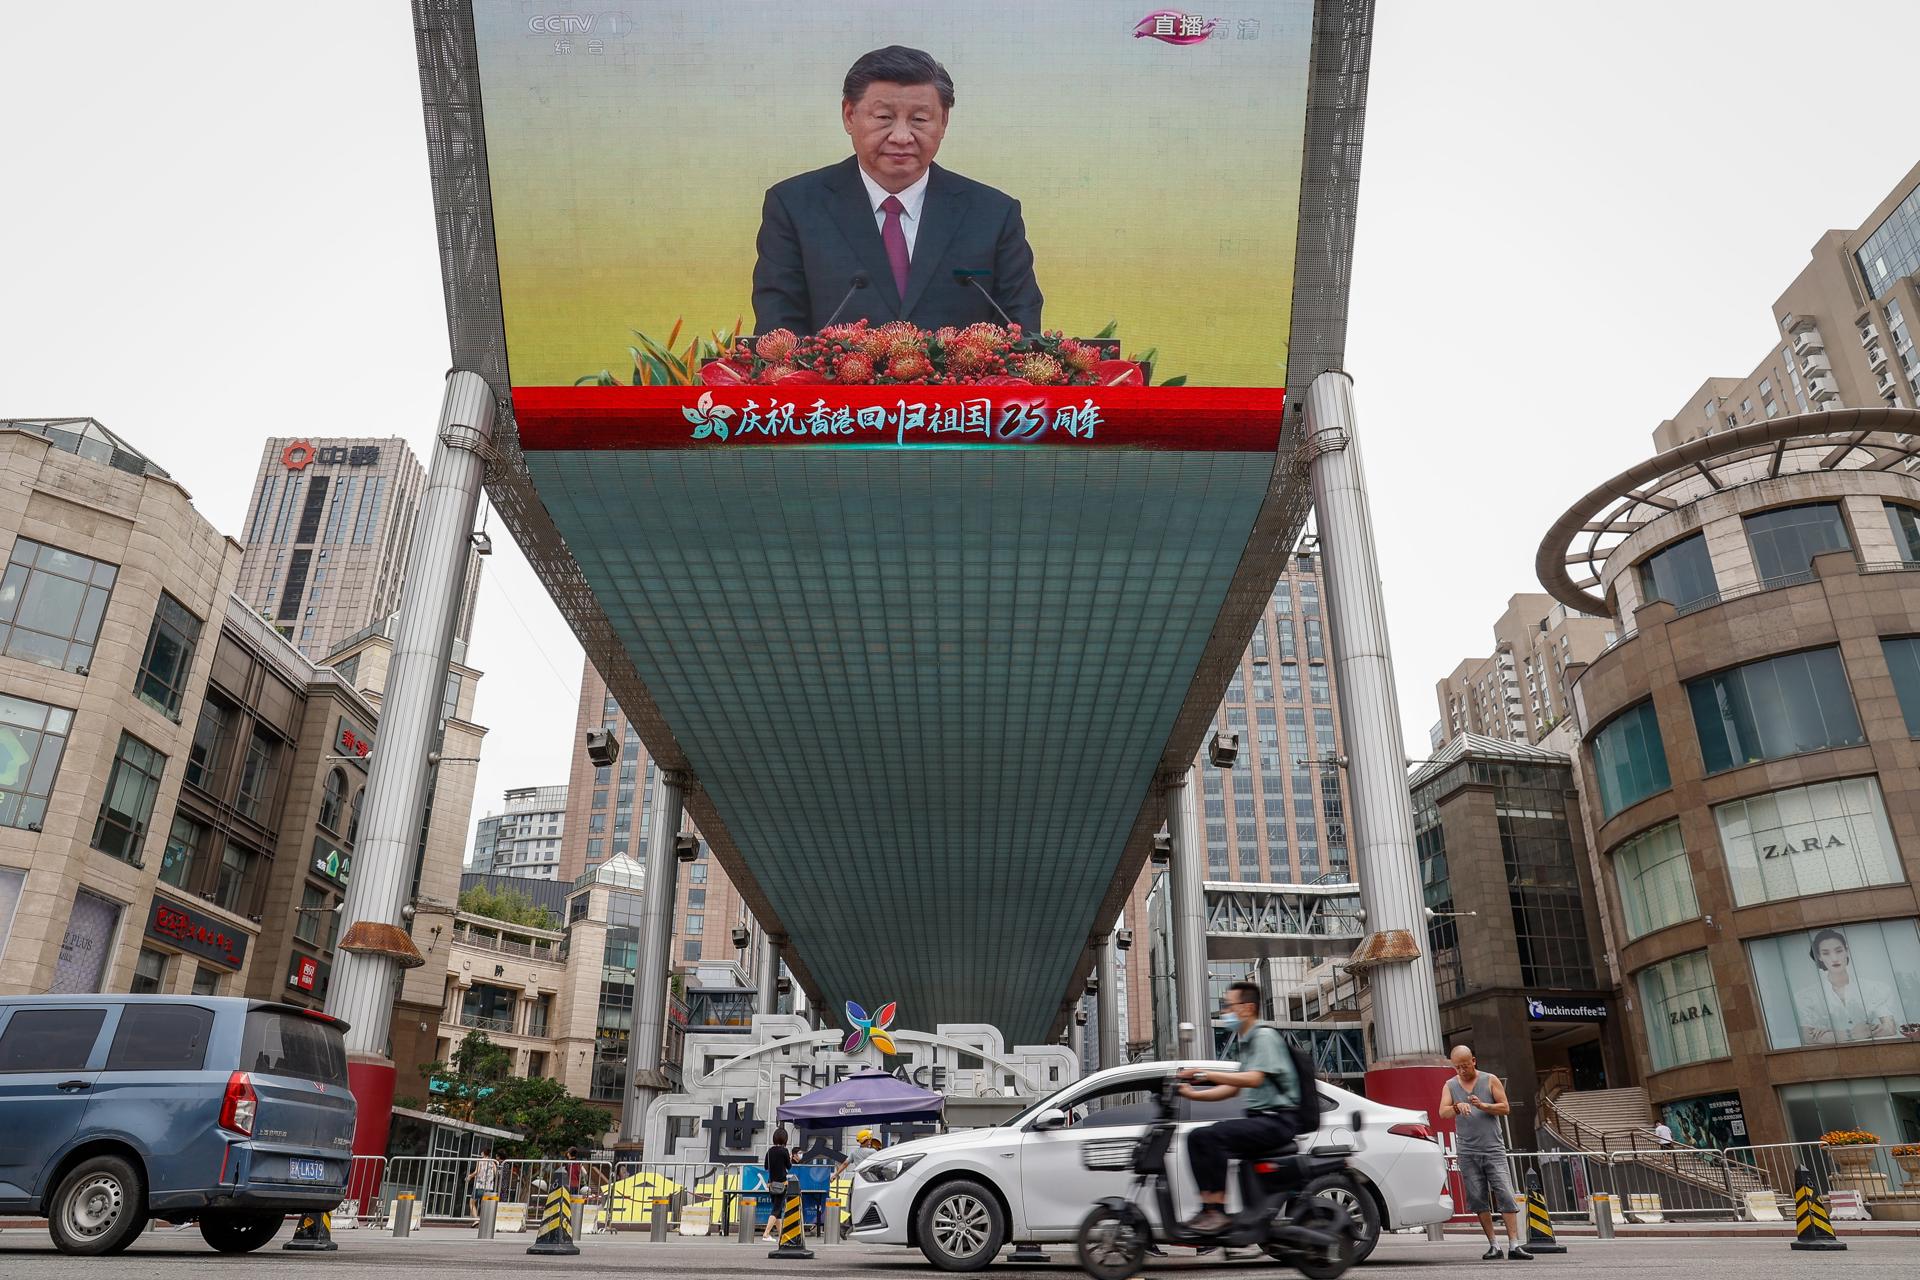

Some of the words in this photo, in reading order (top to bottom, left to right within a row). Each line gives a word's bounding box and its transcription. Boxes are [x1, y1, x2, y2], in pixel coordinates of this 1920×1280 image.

[528, 15, 595, 33] CCTV
[1152, 14, 1203, 36] 直播
[554, 39, 605, 55] 综合
[1763, 834, 1845, 860] ZARA
[1670, 1004, 1713, 1024] ZARA
[839, 1106, 862, 1115] Corona
